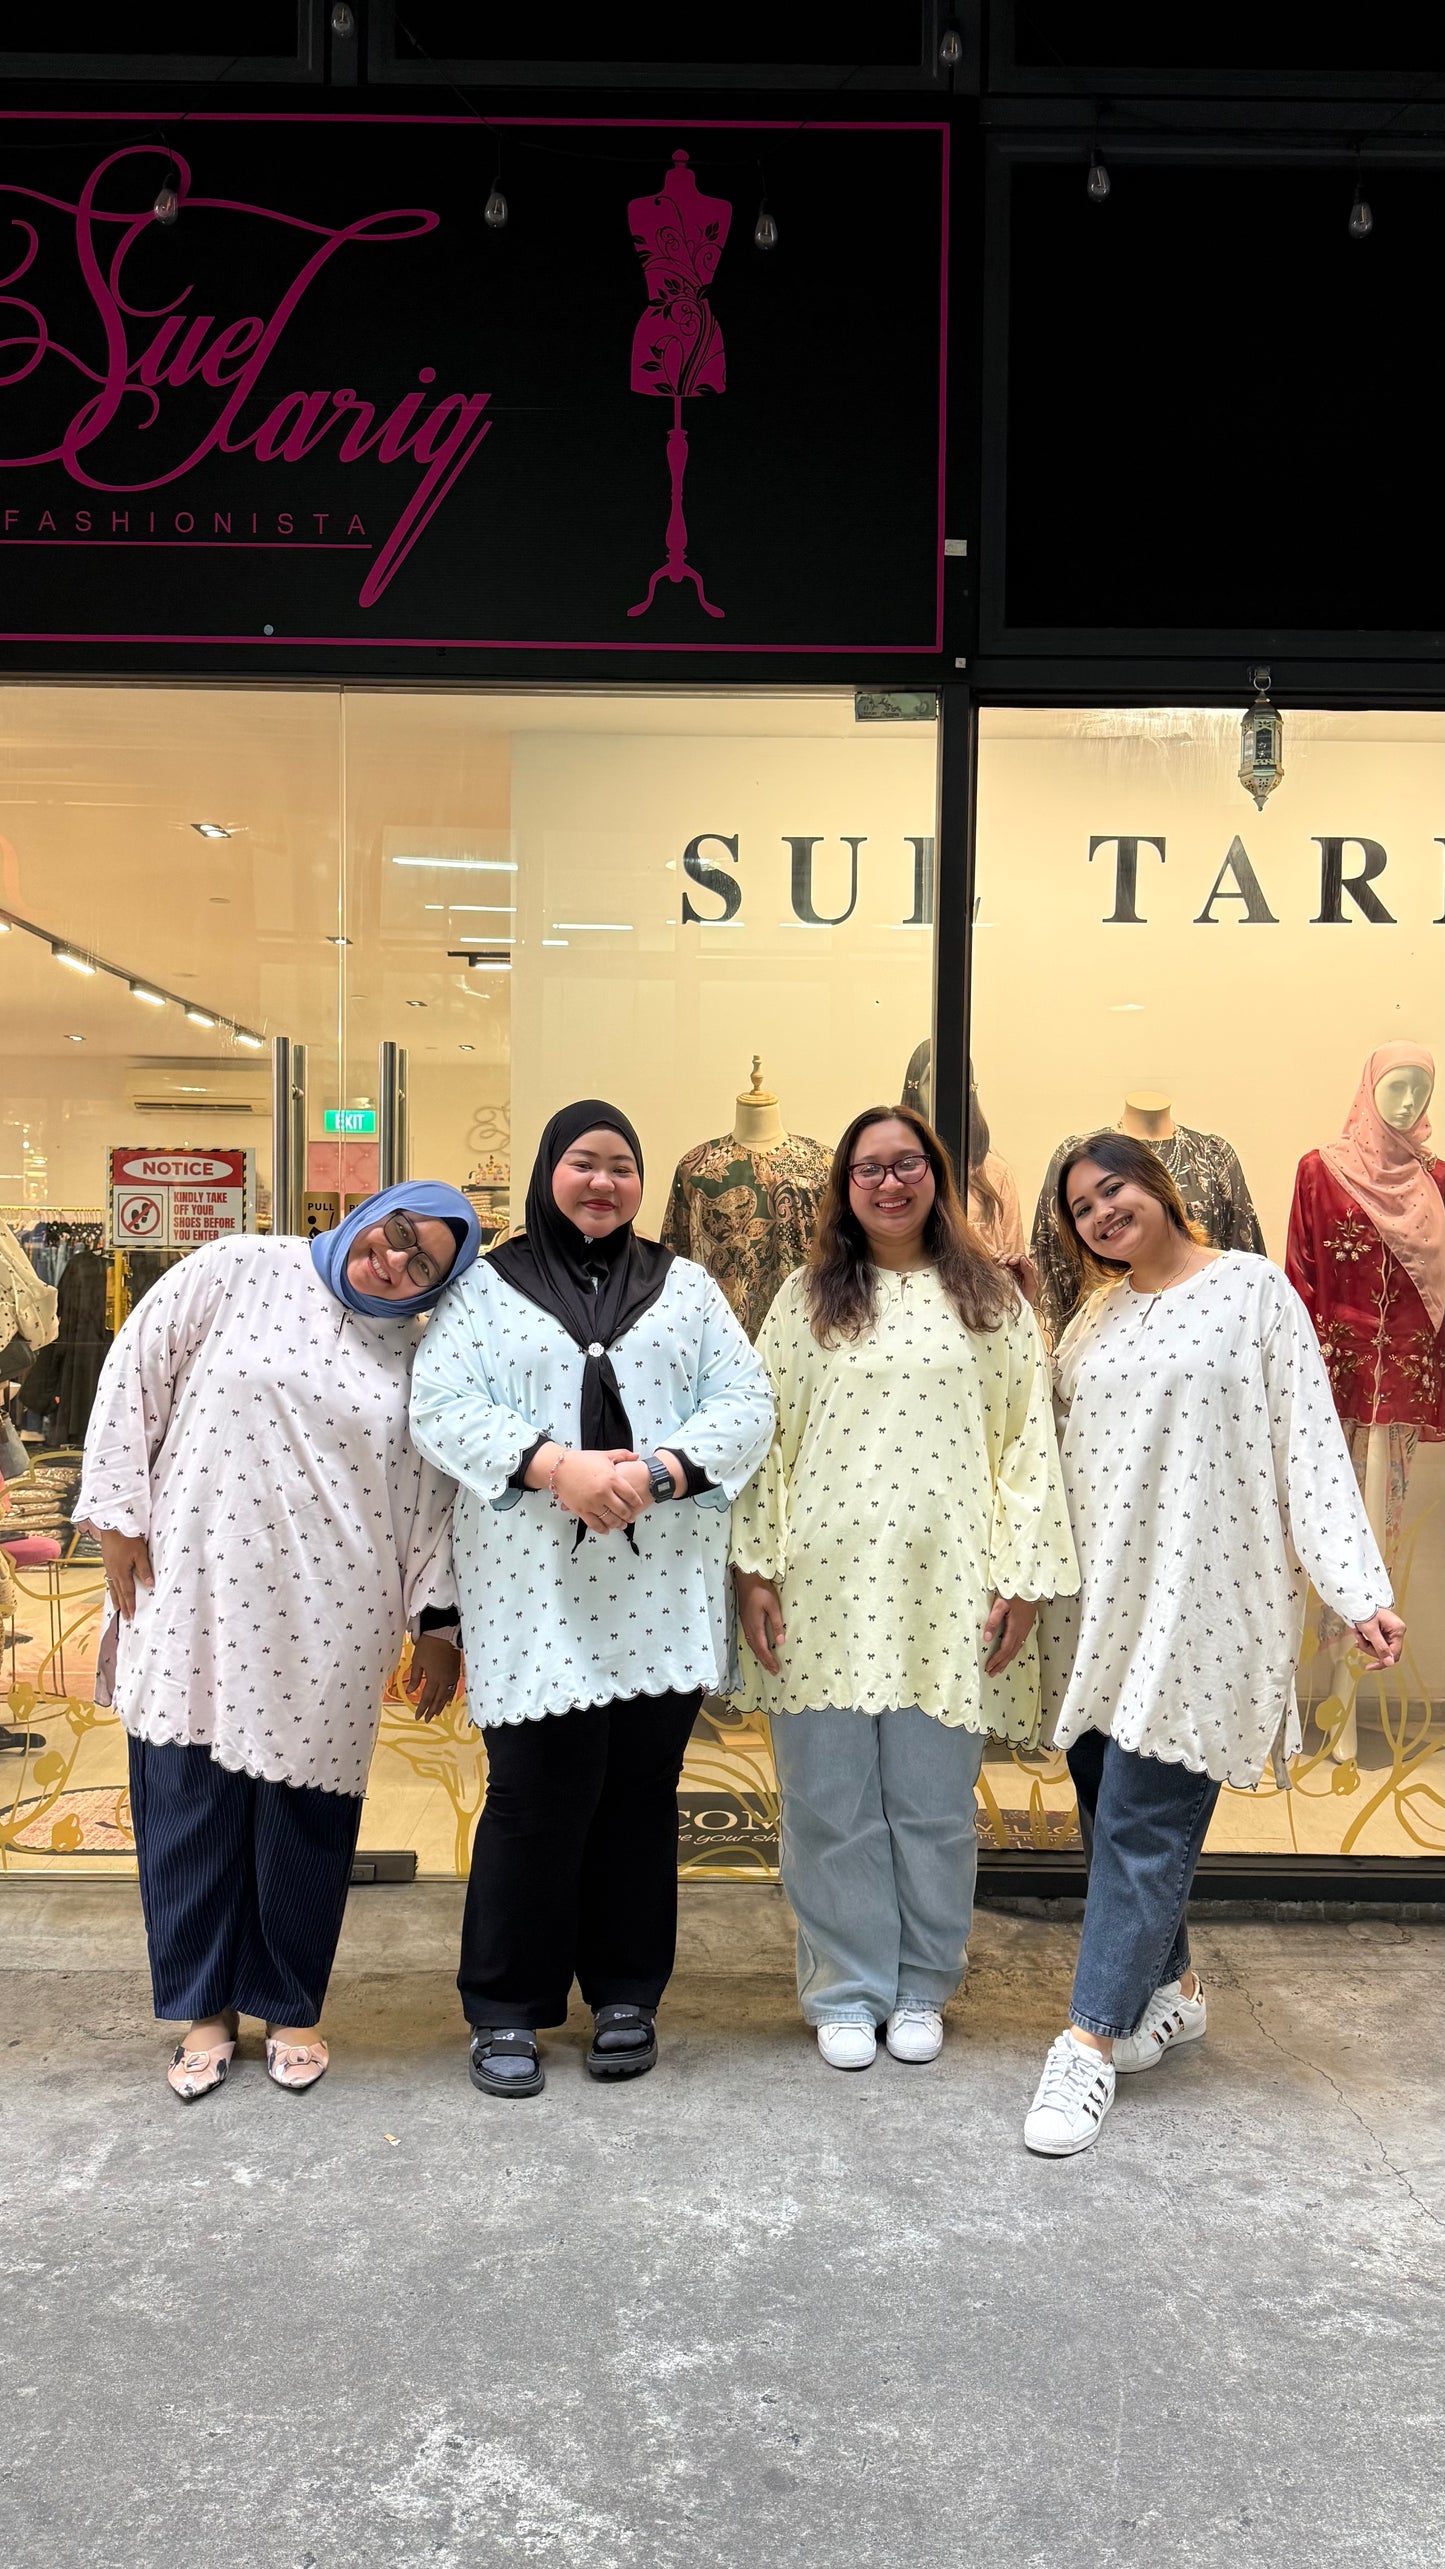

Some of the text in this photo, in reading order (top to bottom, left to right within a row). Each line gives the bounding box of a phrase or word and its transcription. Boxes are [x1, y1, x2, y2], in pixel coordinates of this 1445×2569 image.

[62, 145, 266, 468] Sue
[4, 509, 367, 536] FASHIONISTA
[1088, 834, 1445, 925] TAR
[335, 1112, 366, 1131] EXIT
[142, 1161, 214, 1176] NOTICE
[173, 1191, 228, 1203] KINDLY TAKE
[173, 1205, 214, 1216] OFF YOUR
[307, 1203, 335, 1211] PULL
[173, 1217, 235, 1229] SHOES BEFORE
[173, 1230, 219, 1241] YOU ENTER
[693, 1834, 750, 1845] your
